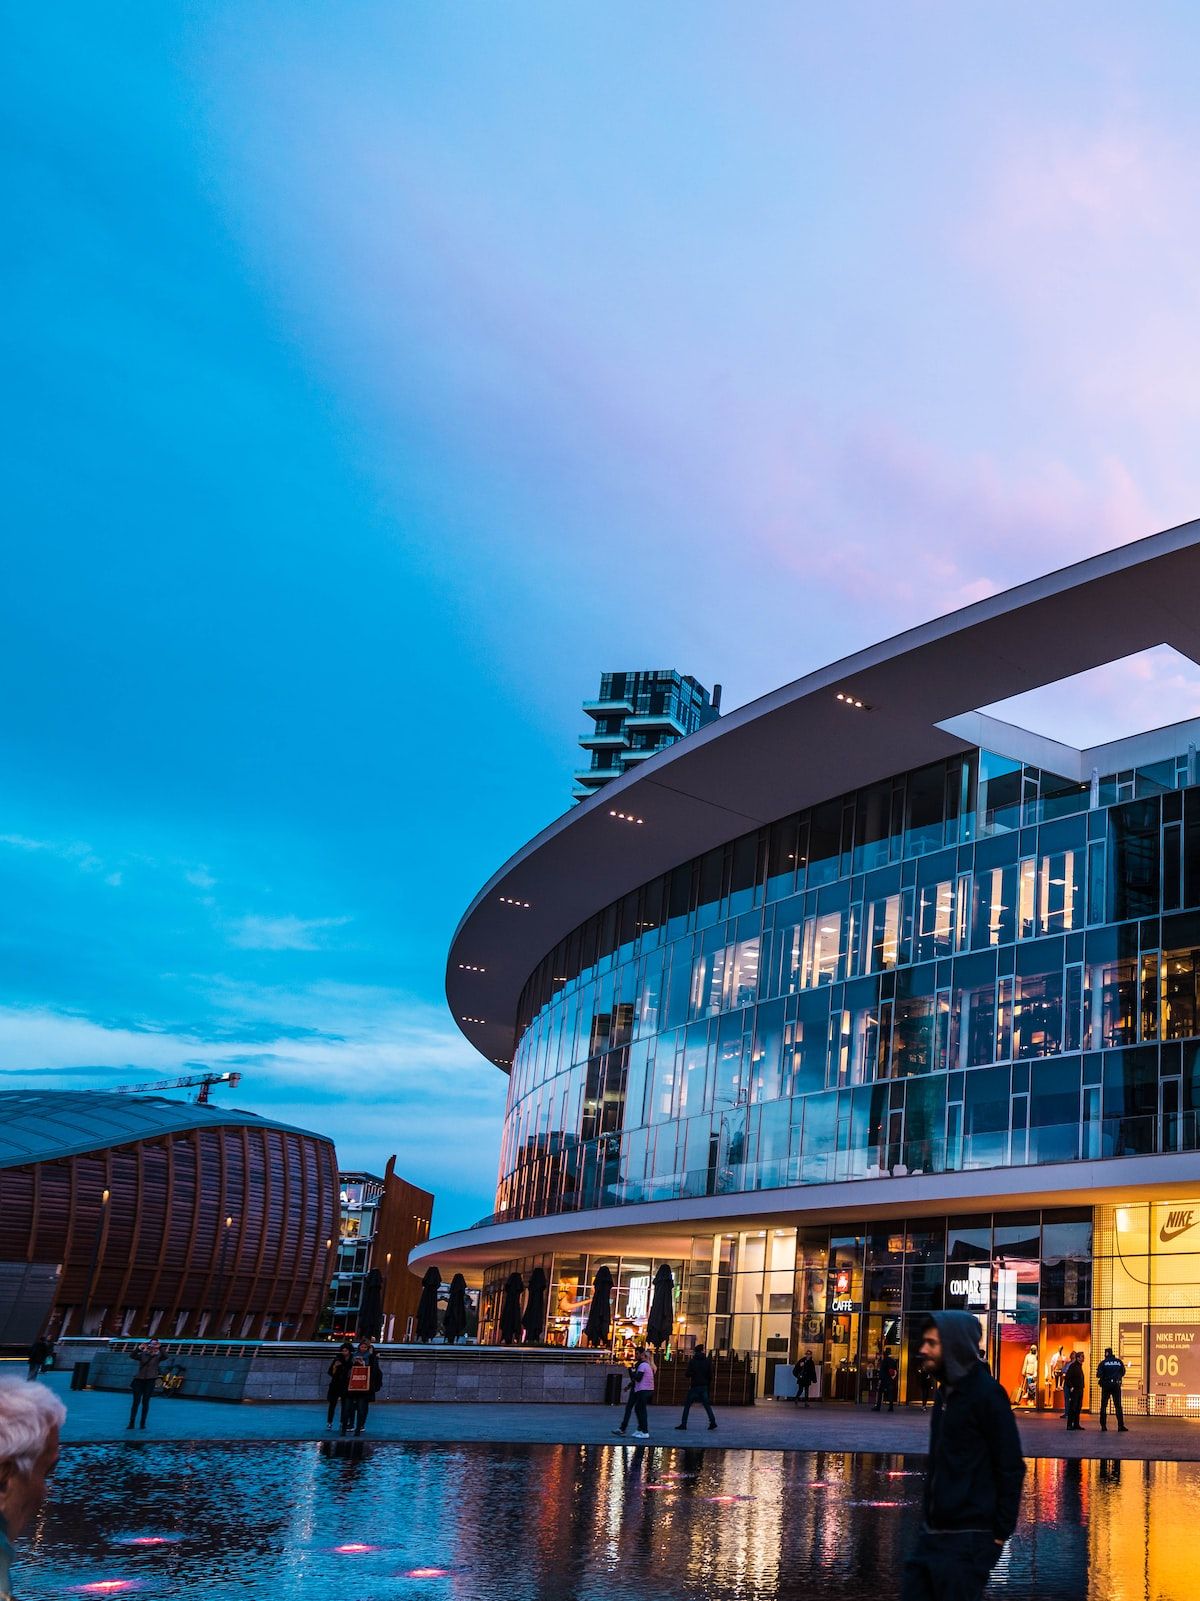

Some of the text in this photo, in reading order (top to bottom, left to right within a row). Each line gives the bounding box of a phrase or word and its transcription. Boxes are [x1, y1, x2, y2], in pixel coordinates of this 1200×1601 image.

[1166, 1210, 1195, 1228] NIKE
[950, 1280, 981, 1295] COLMAR
[832, 1299, 853, 1311] CAFFÈ
[1156, 1333, 1195, 1342] NIKE ITALY
[1155, 1354, 1179, 1376] 06
